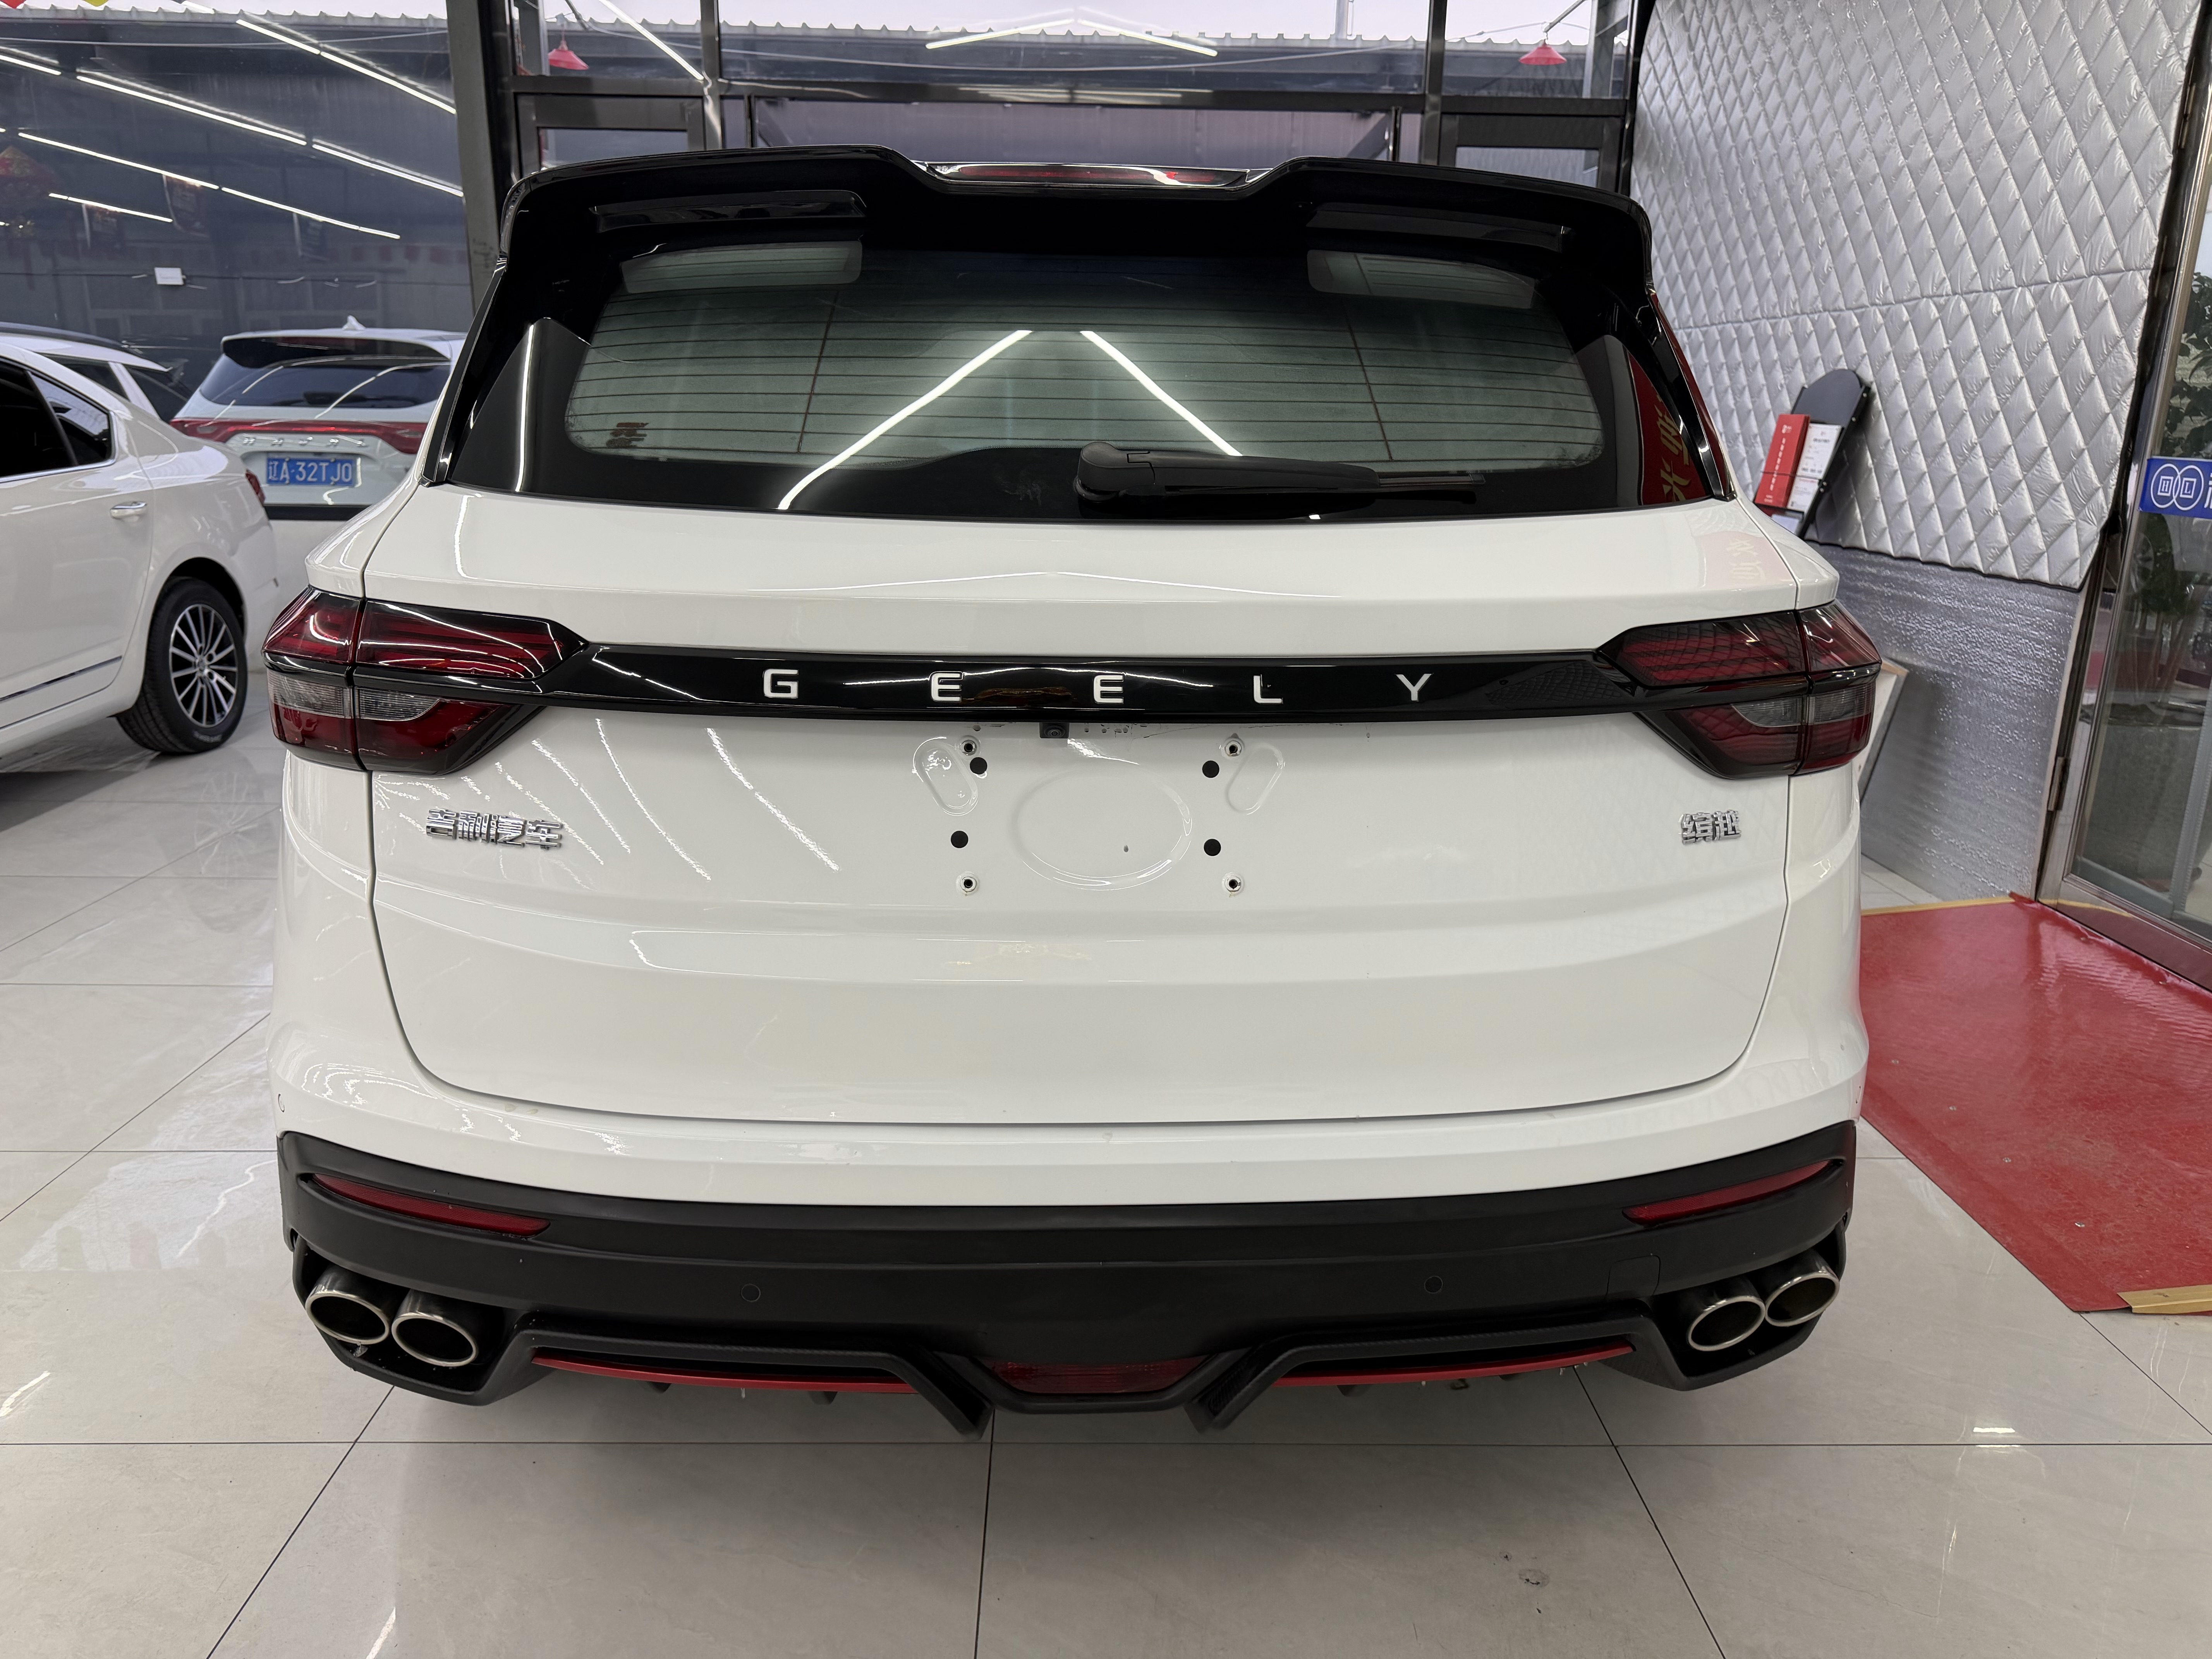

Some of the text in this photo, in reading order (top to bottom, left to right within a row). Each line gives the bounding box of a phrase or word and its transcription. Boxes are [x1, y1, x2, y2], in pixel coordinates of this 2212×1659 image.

[762, 668, 1434, 704] GEELY
[426, 808, 562, 850] 吉利汽车
